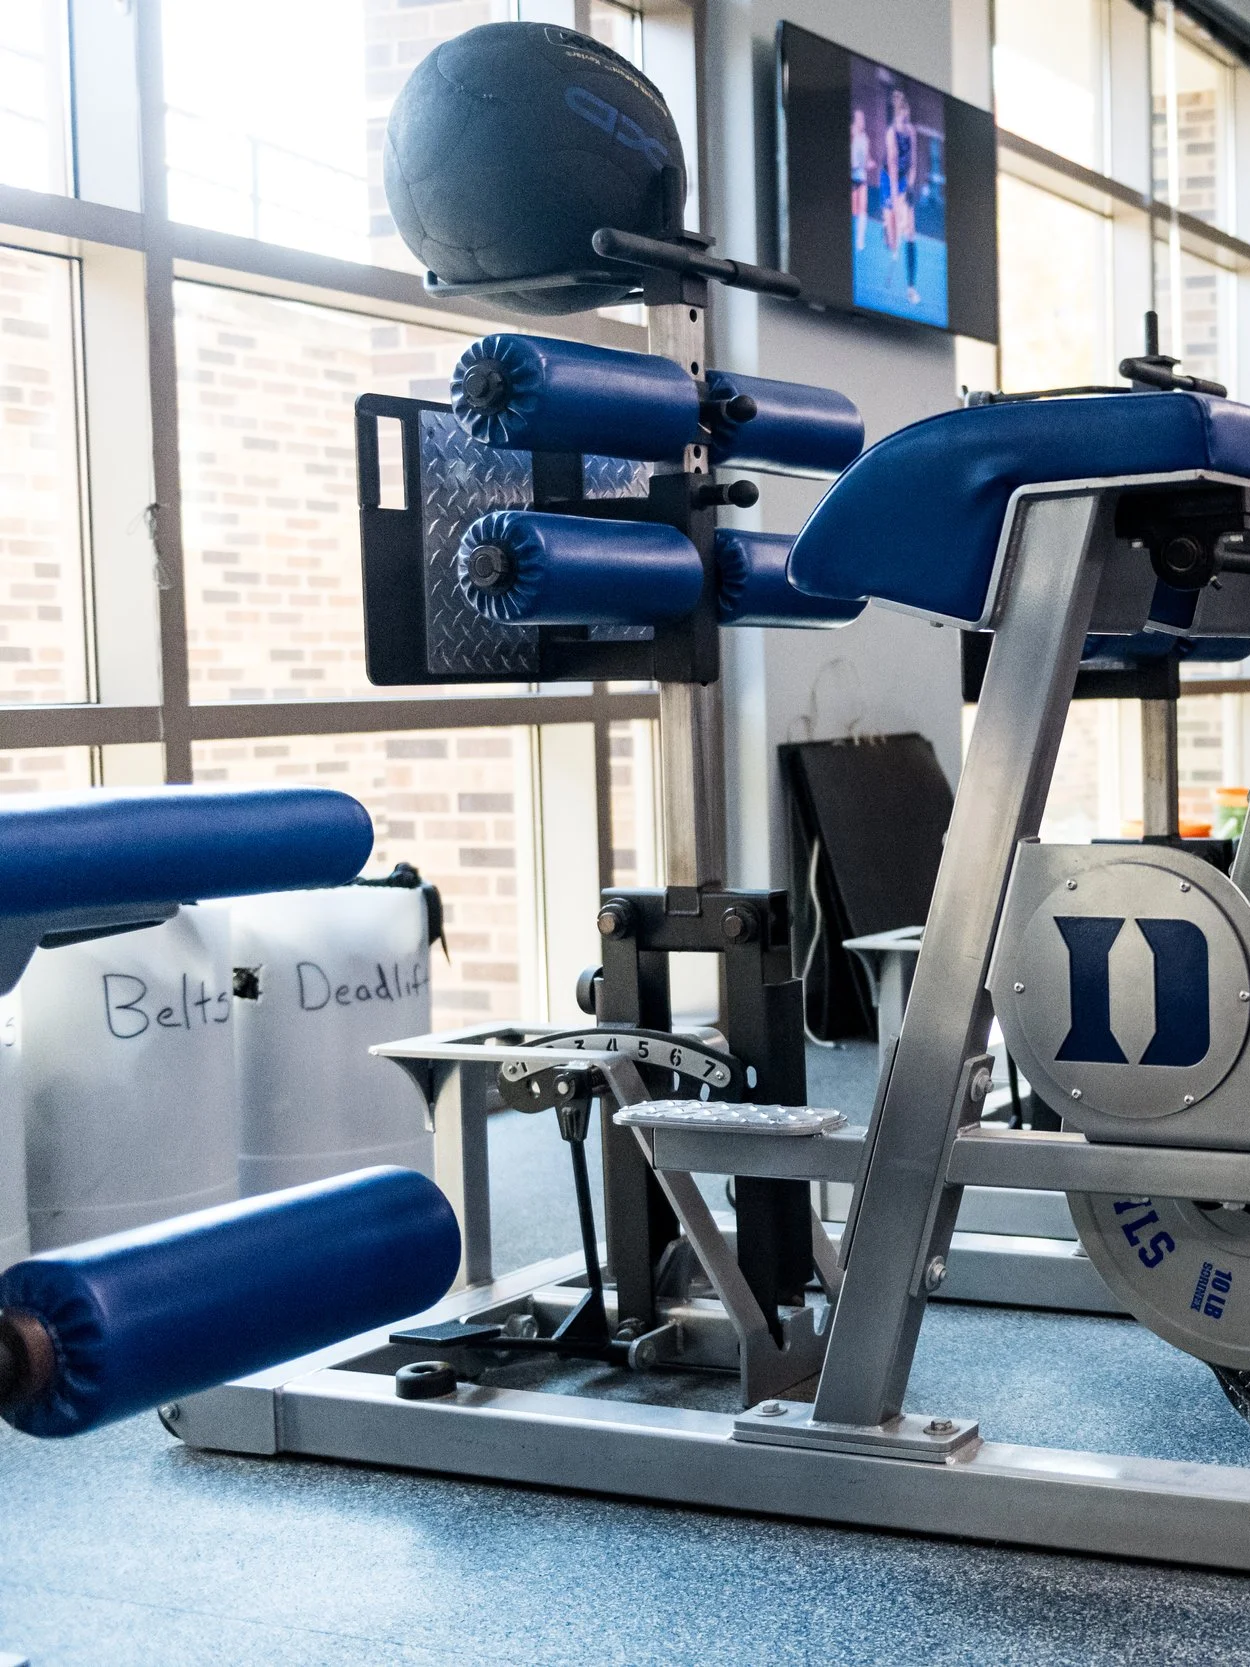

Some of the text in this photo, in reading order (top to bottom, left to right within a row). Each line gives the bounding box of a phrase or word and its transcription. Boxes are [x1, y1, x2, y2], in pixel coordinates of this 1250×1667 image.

[103, 972, 231, 1039] Belts
[297, 961, 429, 1011] Deadlif
[638, 1040, 649, 1058] 5
[669, 1047, 682, 1067] 6
[702, 1059, 717, 1078] 7
[1203, 1269, 1233, 1320] 10 LB
